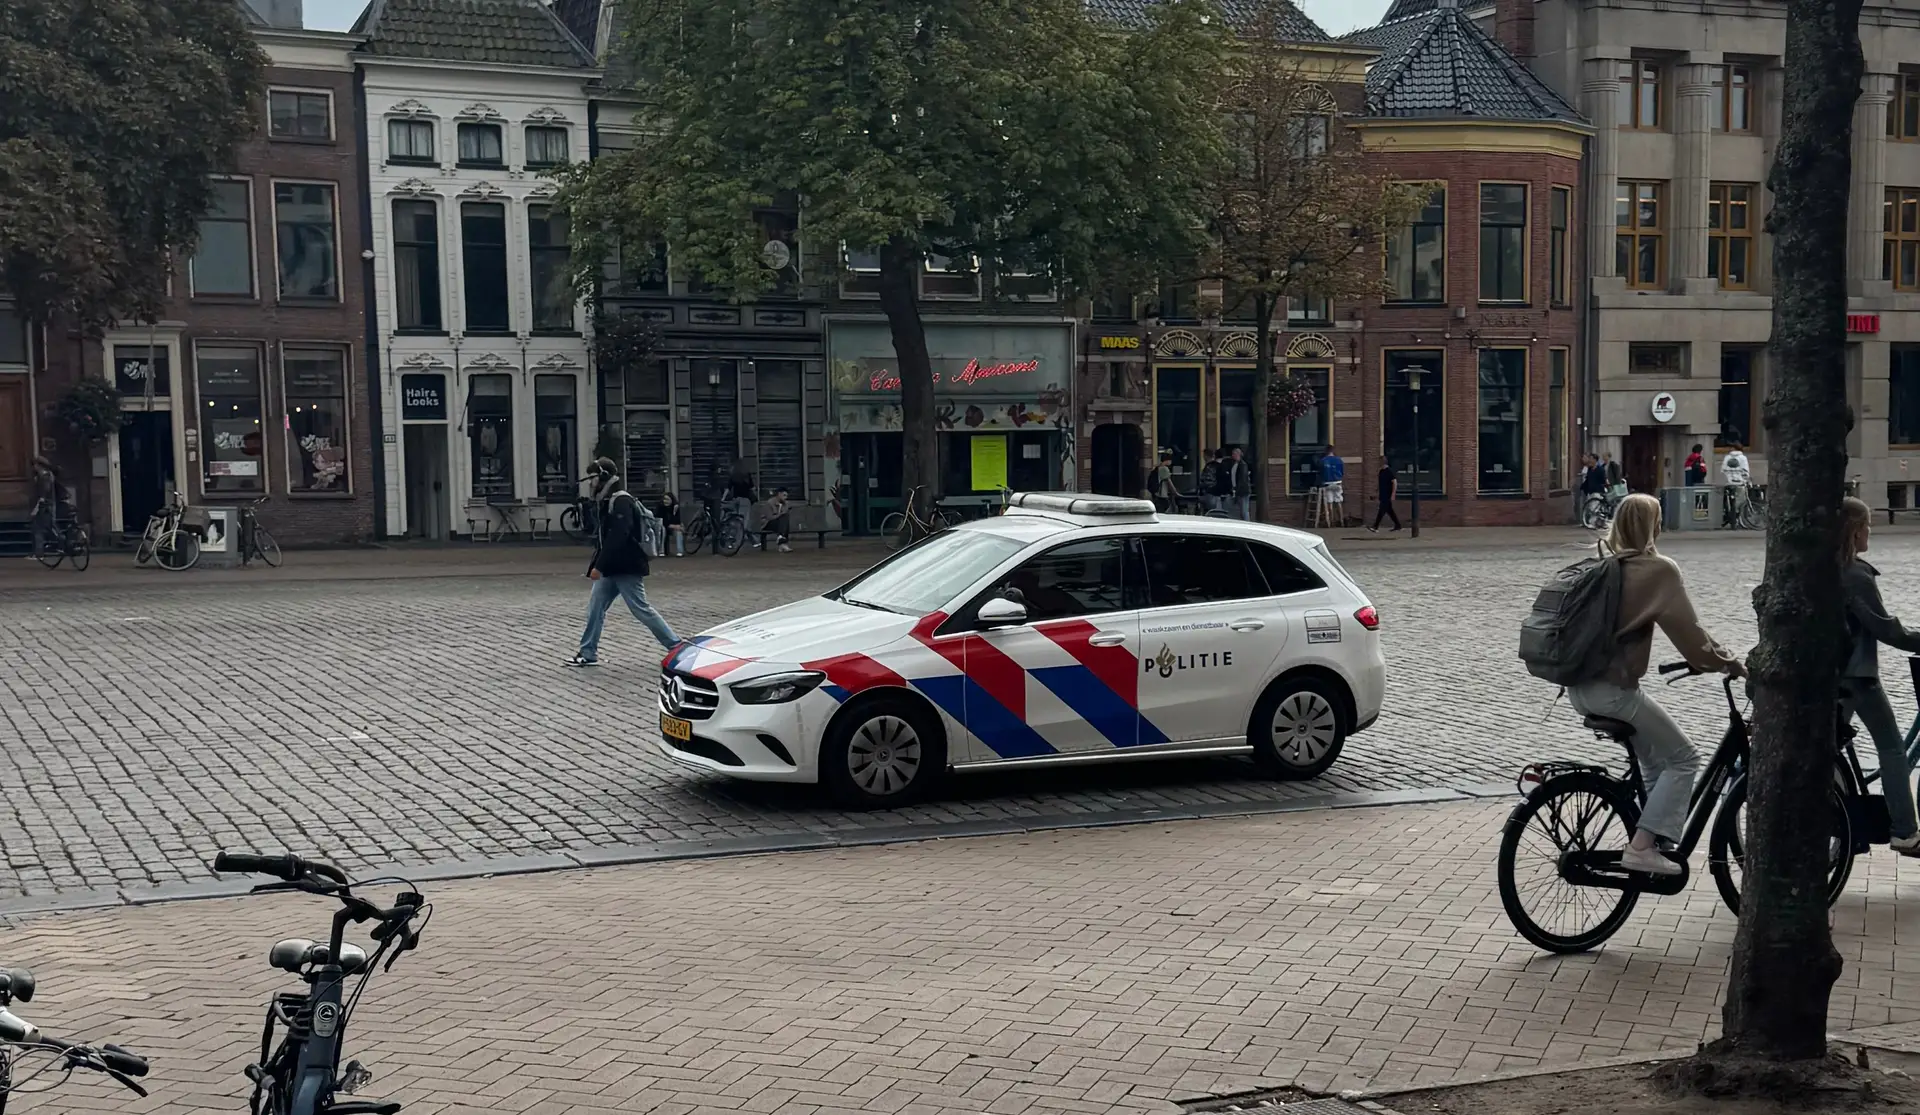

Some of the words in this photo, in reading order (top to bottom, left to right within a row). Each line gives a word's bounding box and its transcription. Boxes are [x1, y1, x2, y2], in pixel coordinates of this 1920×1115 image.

[1100, 336, 1140, 349] MAAS
[406, 397, 440, 406] Looks
[1145, 651, 1232, 678] POLITIE
